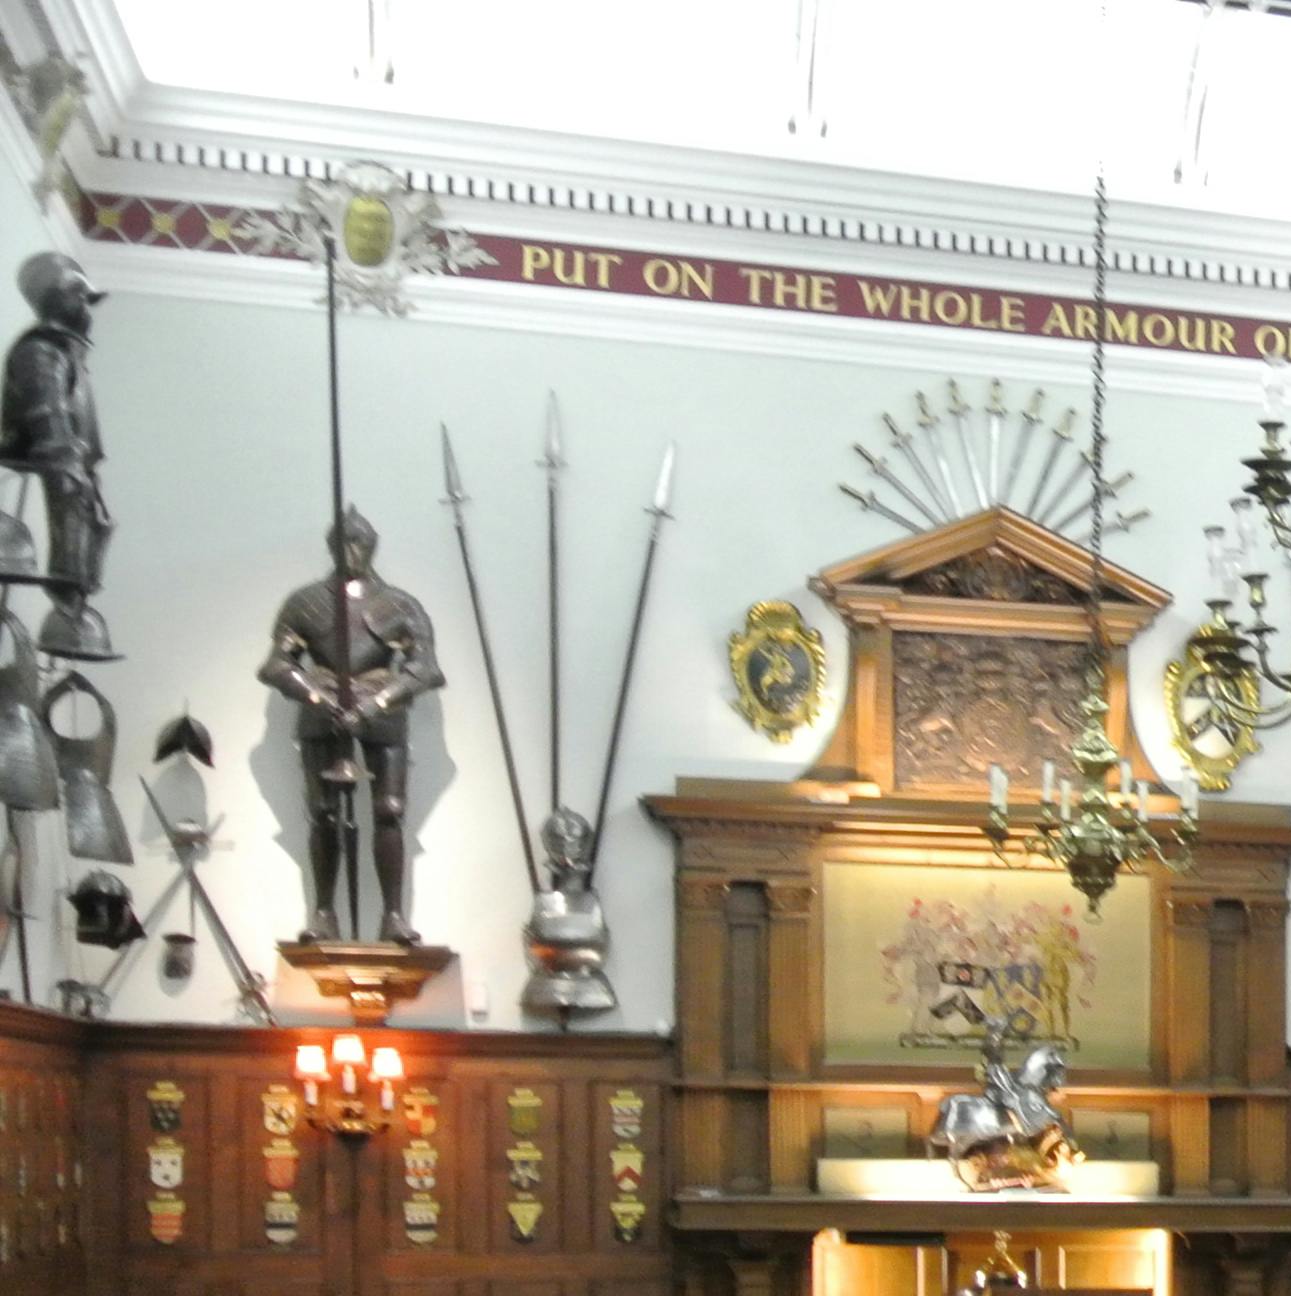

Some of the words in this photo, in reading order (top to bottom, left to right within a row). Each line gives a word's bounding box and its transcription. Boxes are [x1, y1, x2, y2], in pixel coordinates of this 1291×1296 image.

[521, 244, 623, 288] PUT
[642, 257, 715, 300] ON
[739, 266, 838, 312] THE
[856, 280, 1026, 332] WHOLE
[1040, 303, 1238, 354] ARMOUR
